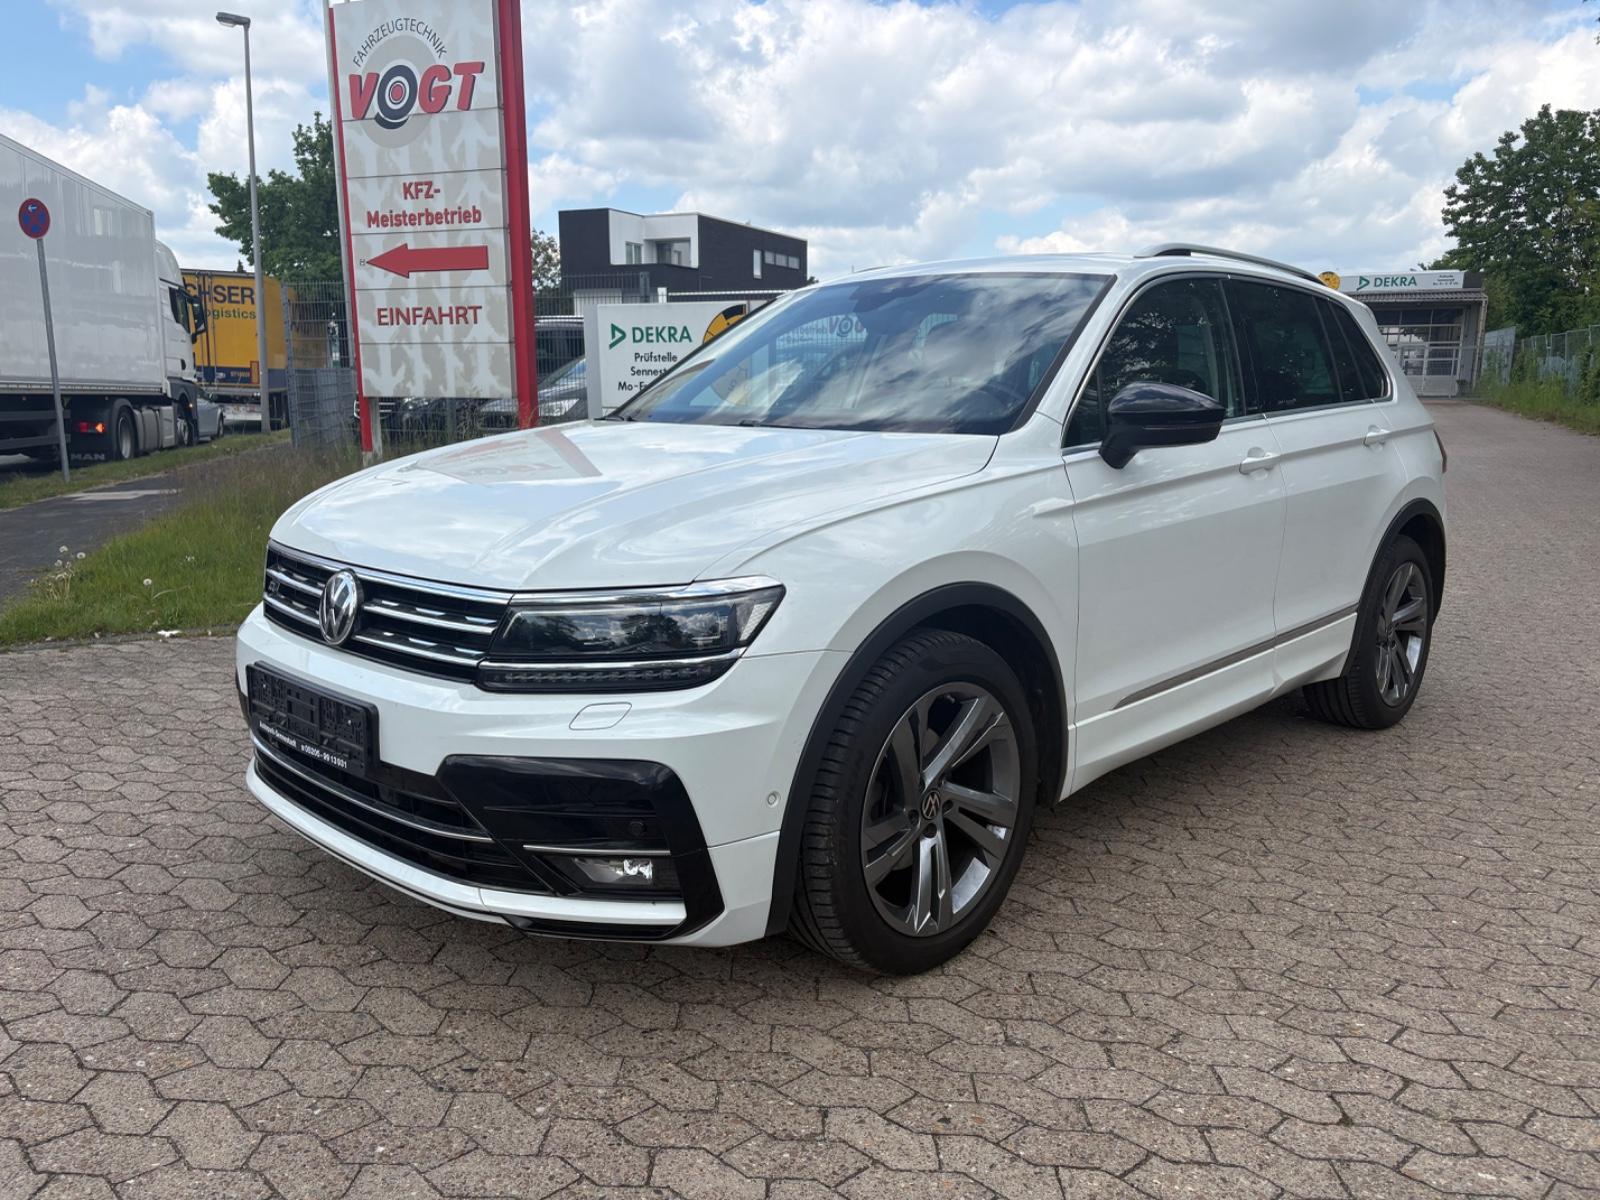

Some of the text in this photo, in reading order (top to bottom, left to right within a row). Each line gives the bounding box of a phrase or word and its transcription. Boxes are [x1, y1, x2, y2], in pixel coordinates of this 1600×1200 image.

[353, 17, 448, 67] FAHRZEUGTECHNIK
[348, 61, 485, 122] VOGT
[402, 180, 441, 200] KFZ-
[367, 205, 482, 228] Meisterbetrieb
[1374, 276, 1417, 287] DEKRA
[206, 307, 257, 320] ogistics
[376, 305, 483, 326] EINFAHRT
[632, 325, 693, 344] DEKRA
[634, 351, 678, 363] Prüfstelle
[617, 381, 649, 392] Mo-F
